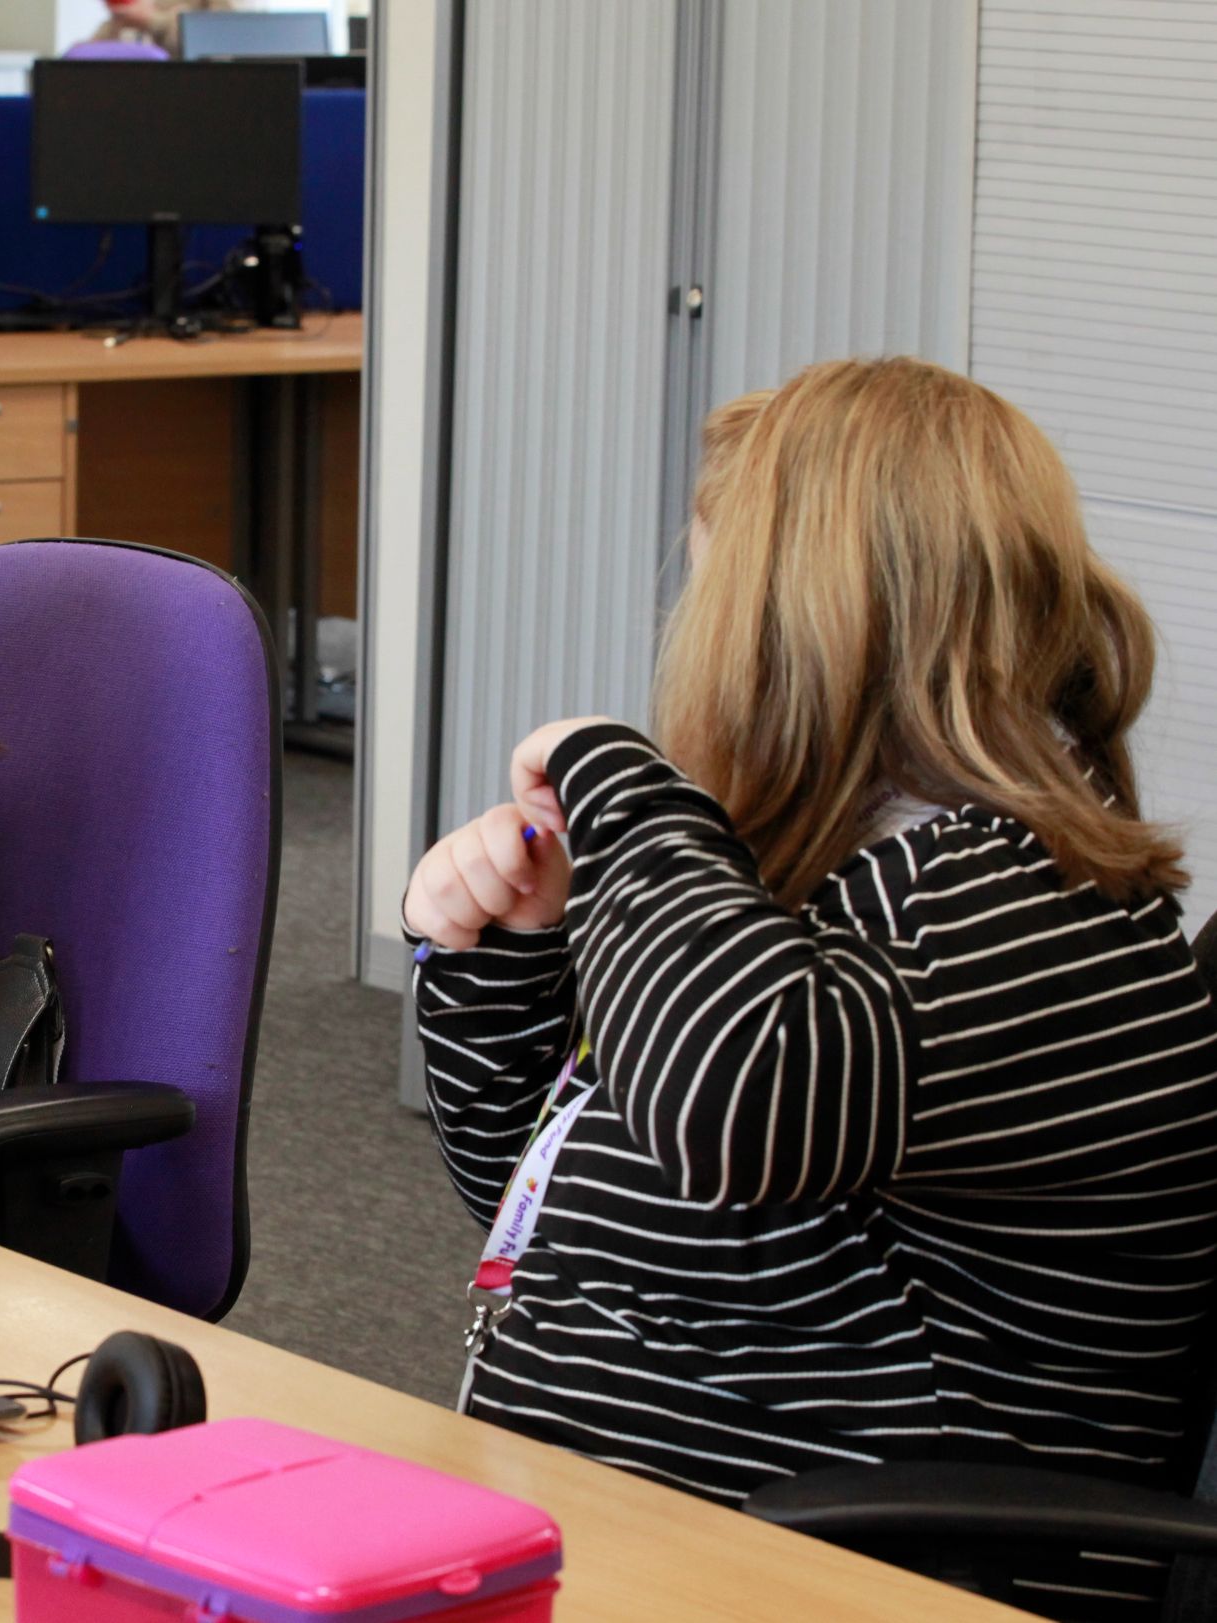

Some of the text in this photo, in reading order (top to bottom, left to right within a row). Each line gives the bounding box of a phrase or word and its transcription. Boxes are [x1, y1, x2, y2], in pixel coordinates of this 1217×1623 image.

[540, 1125, 562, 1160] Fund
[499, 1194, 533, 1255] Family Fu
